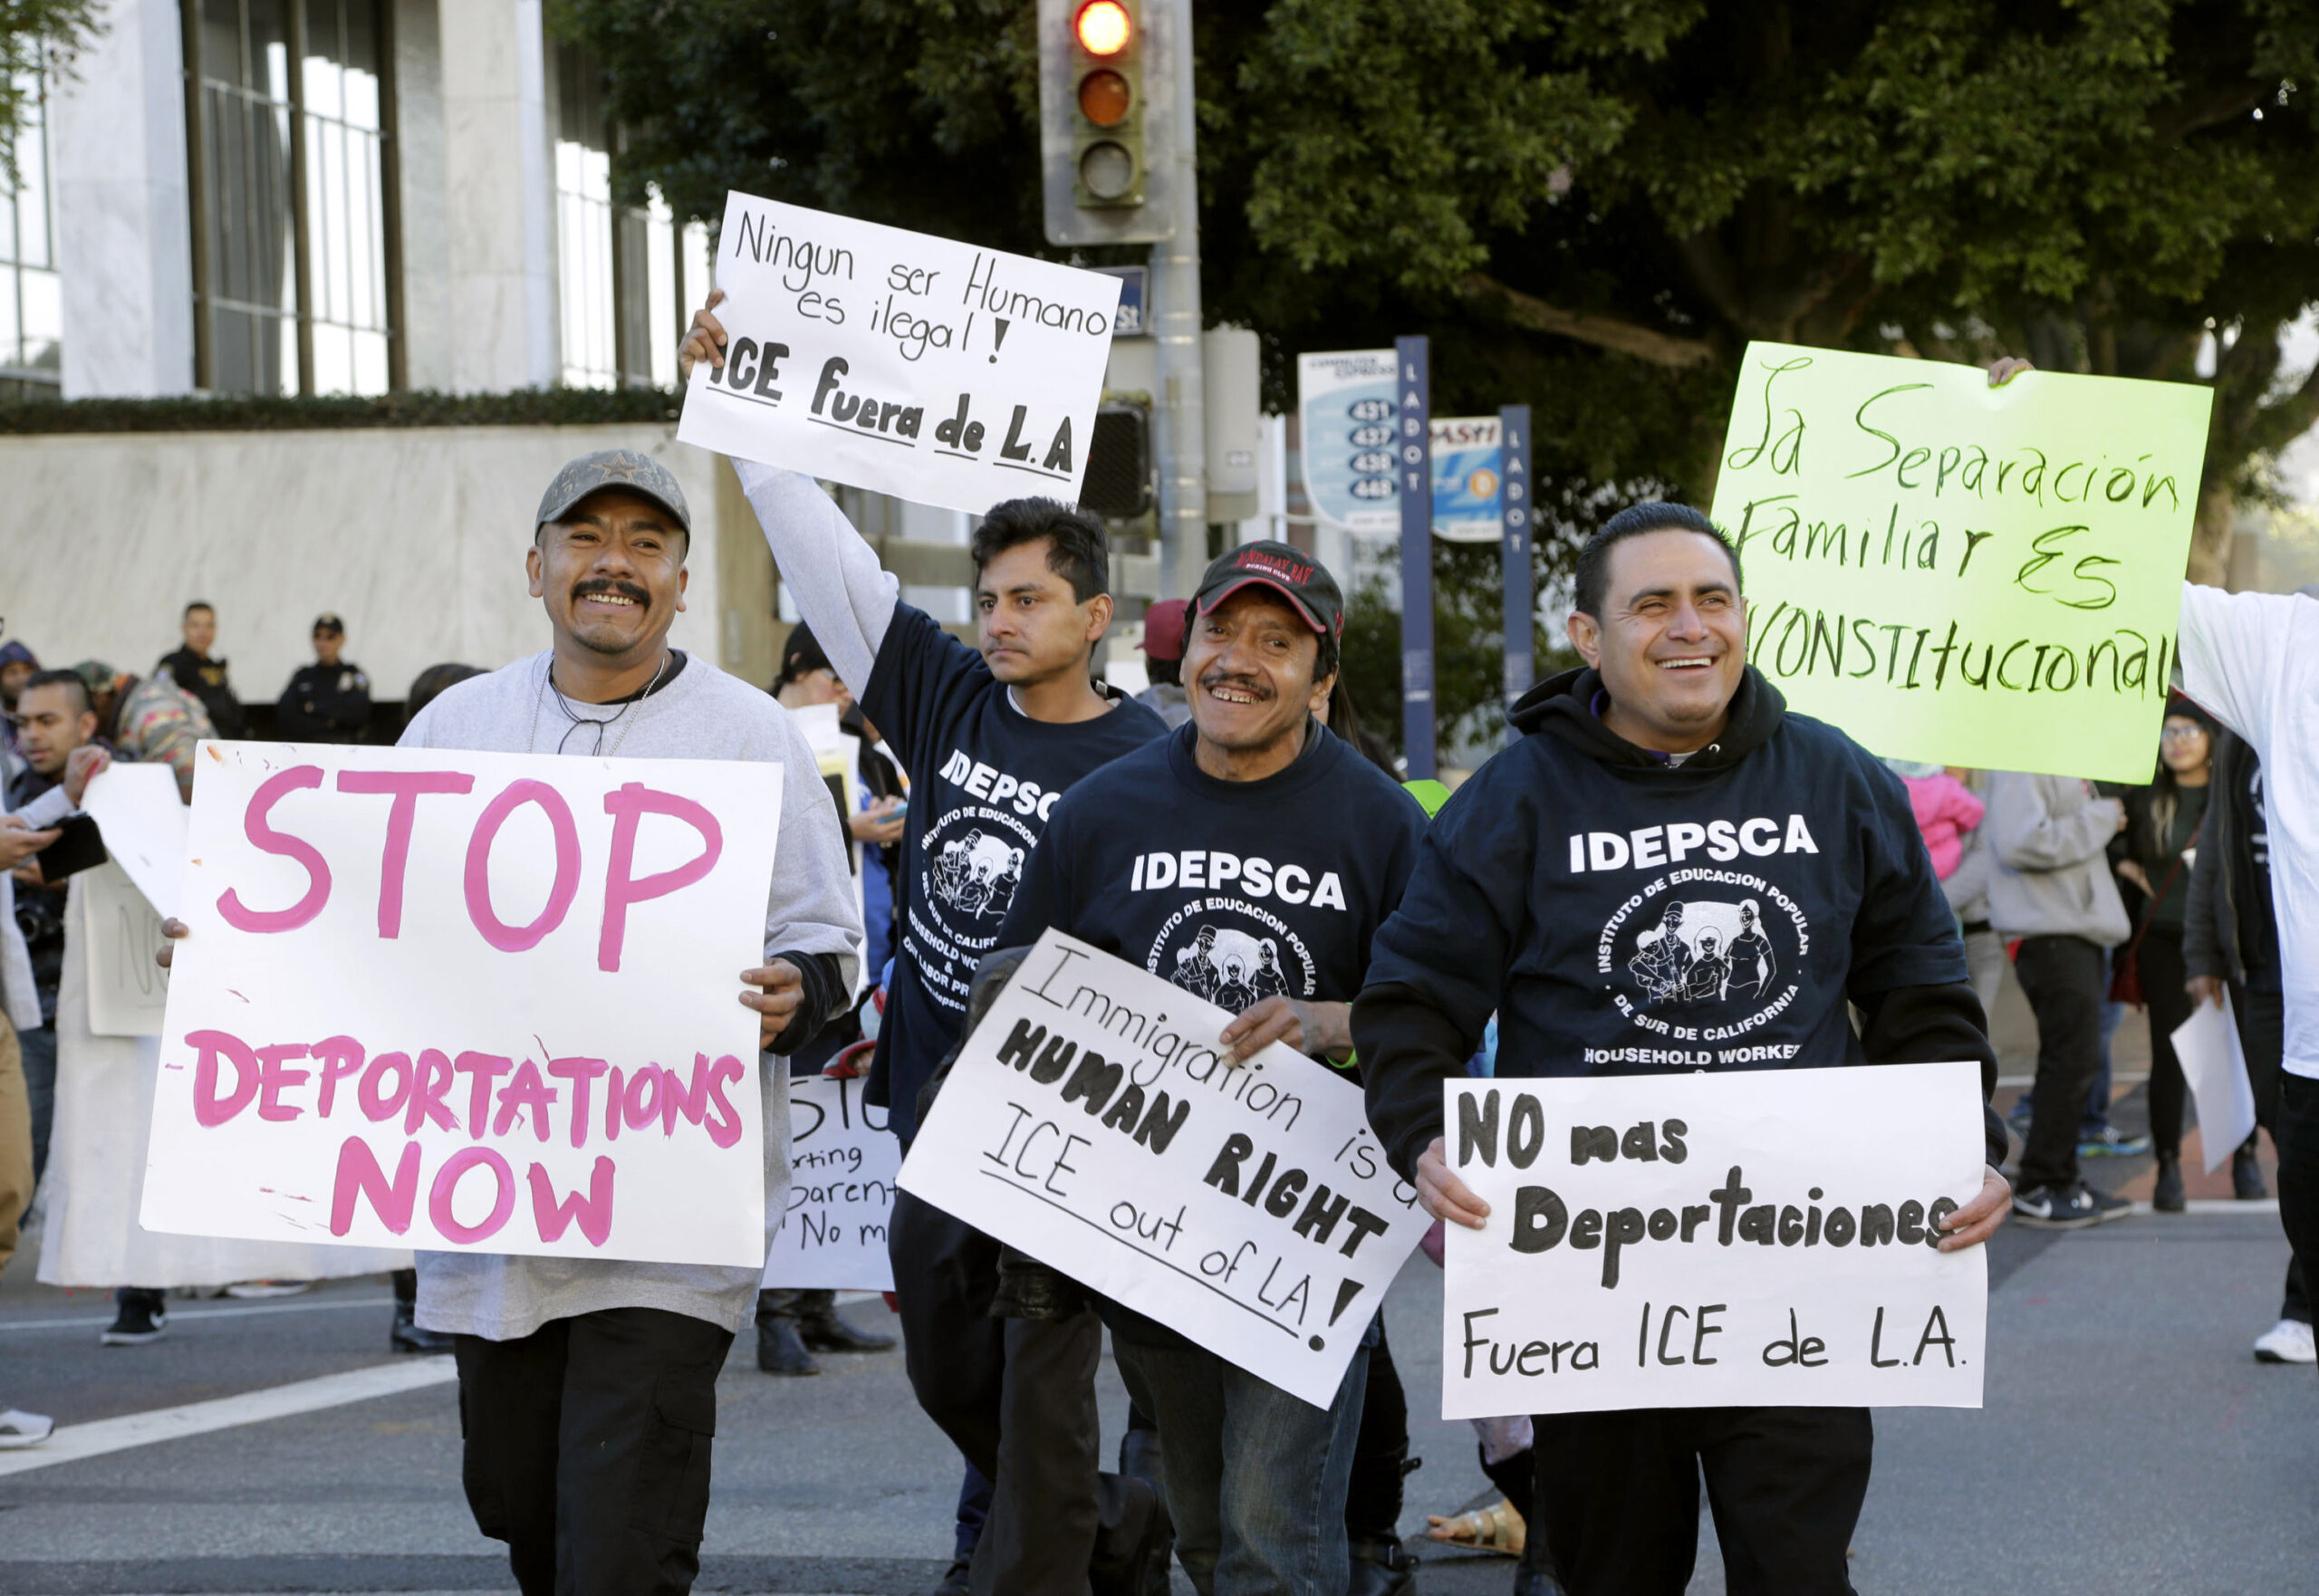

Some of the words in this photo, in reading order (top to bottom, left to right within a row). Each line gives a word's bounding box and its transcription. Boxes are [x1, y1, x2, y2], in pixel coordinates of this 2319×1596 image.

[736, 210, 853, 292] Ningun
[888, 264, 940, 296] ser
[963, 252, 1107, 336] Humano
[797, 291, 845, 325] es
[935, 393, 986, 453] de
[999, 404, 1073, 473] L.A
[1352, 400, 1390, 421] 431
[1352, 427, 1392, 447] 437
[1429, 424, 1495, 444] ASH
[938, 748, 1062, 823] IDEPSC
[962, 805, 977, 818] DE
[216, 764, 723, 973] STOP
[1131, 850, 1347, 911] IDEPSCA
[1569, 813, 1820, 874] IDEPSCA
[954, 932, 997, 949] CALIF
[1146, 911, 1182, 976] STITUTO
[1183, 899, 1203, 918] DE
[1205, 897, 1288, 936] EDUCACION
[1285, 931, 1316, 996] POPULAR
[1597, 896, 1643, 974] INSTITUTO
[1643, 878, 1667, 898] DE
[1669, 868, 1766, 893] EDUCACION
[1766, 886, 1809, 957] POPULAR
[919, 954, 949, 988] LABOR
[1634, 1014, 1669, 1036] SUR
[1673, 1026, 1698, 1041] DE
[1703, 984, 1799, 1041] CALIFORNIA
[184, 1029, 745, 1149] DEPORTATIONS
[1020, 944, 1302, 1132] Immigration
[1333, 1128, 1377, 1179] is
[1583, 1047, 1711, 1065] HOUSEHOLD
[996, 1017, 1192, 1156] HUMAN
[1202, 1132, 1390, 1259] RIGHT
[1458, 1088, 1544, 1169] NO
[1570, 1118, 1689, 1165] mas
[330, 1134, 615, 1248] NOW
[983, 1101, 1092, 1197] ICE
[1110, 1200, 1187, 1252] out
[1199, 1240, 1257, 1283] of
[801, 1210, 841, 1250] No
[1462, 1307, 1600, 1379] Fuera
[1638, 1302, 1727, 1368] ICE
[1762, 1307, 1830, 1368] de
[1870, 1304, 1968, 1369] L.A.
